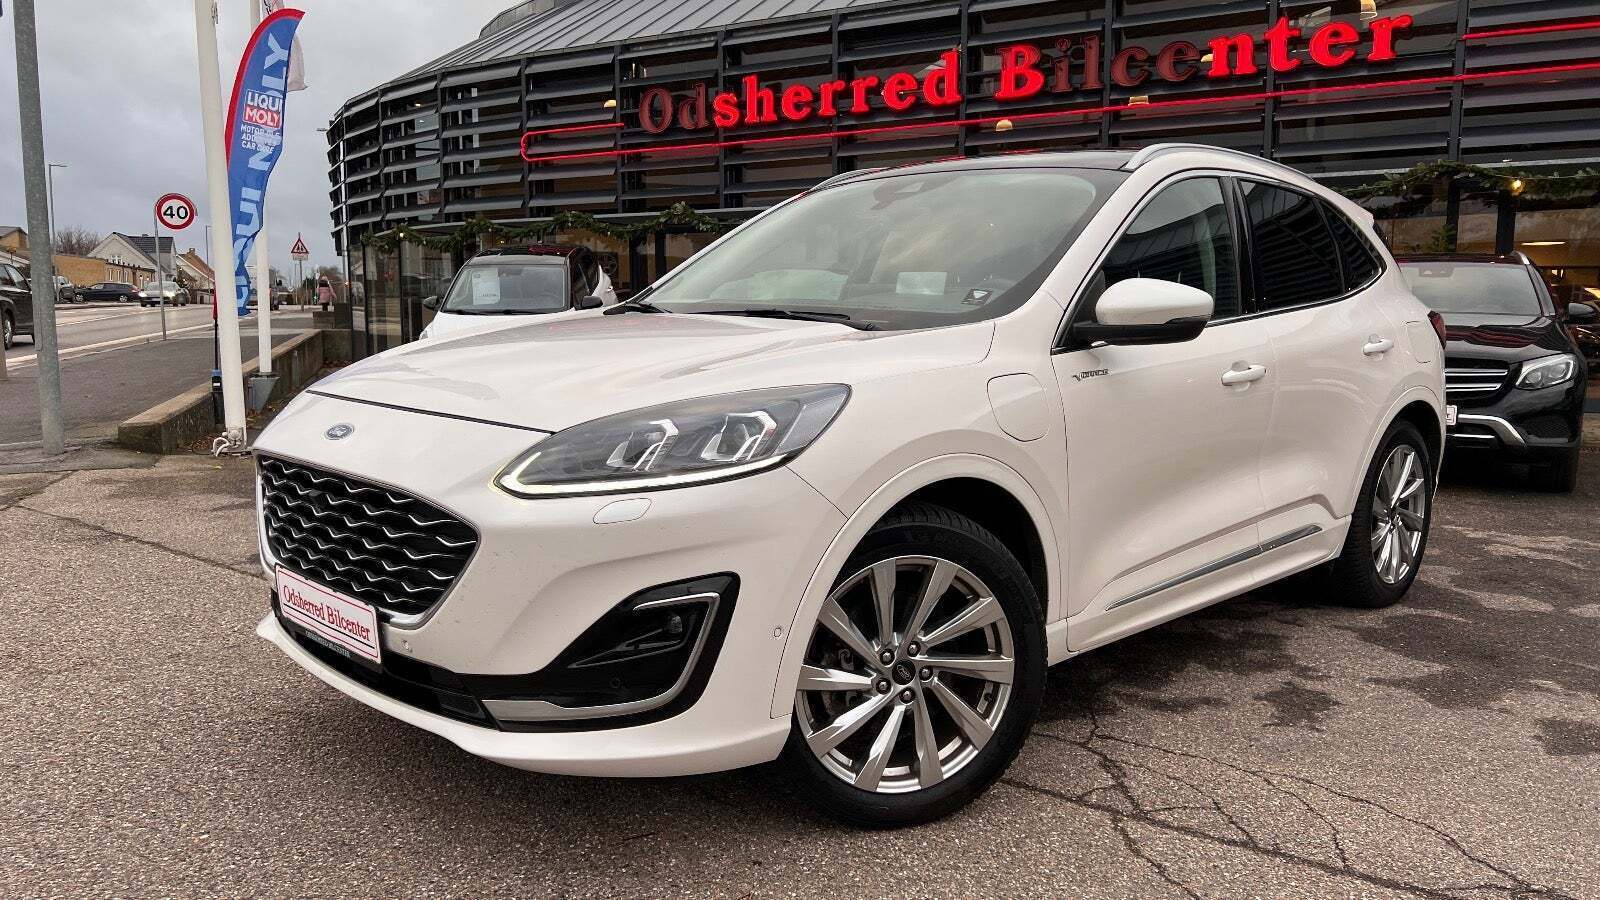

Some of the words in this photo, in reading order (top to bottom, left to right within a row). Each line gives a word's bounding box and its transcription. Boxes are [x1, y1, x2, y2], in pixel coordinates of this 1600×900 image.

[639, 47, 964, 134] Odsherred
[994, 14, 1413, 99] Bilcenter
[247, 92, 283, 112] LIQUI
[245, 107, 280, 127] MOLY
[241, 140, 257, 150] CAR
[163, 205, 189, 220] 40
[283, 585, 326, 620] Odsherred
[326, 604, 370, 641] Bilcenter
